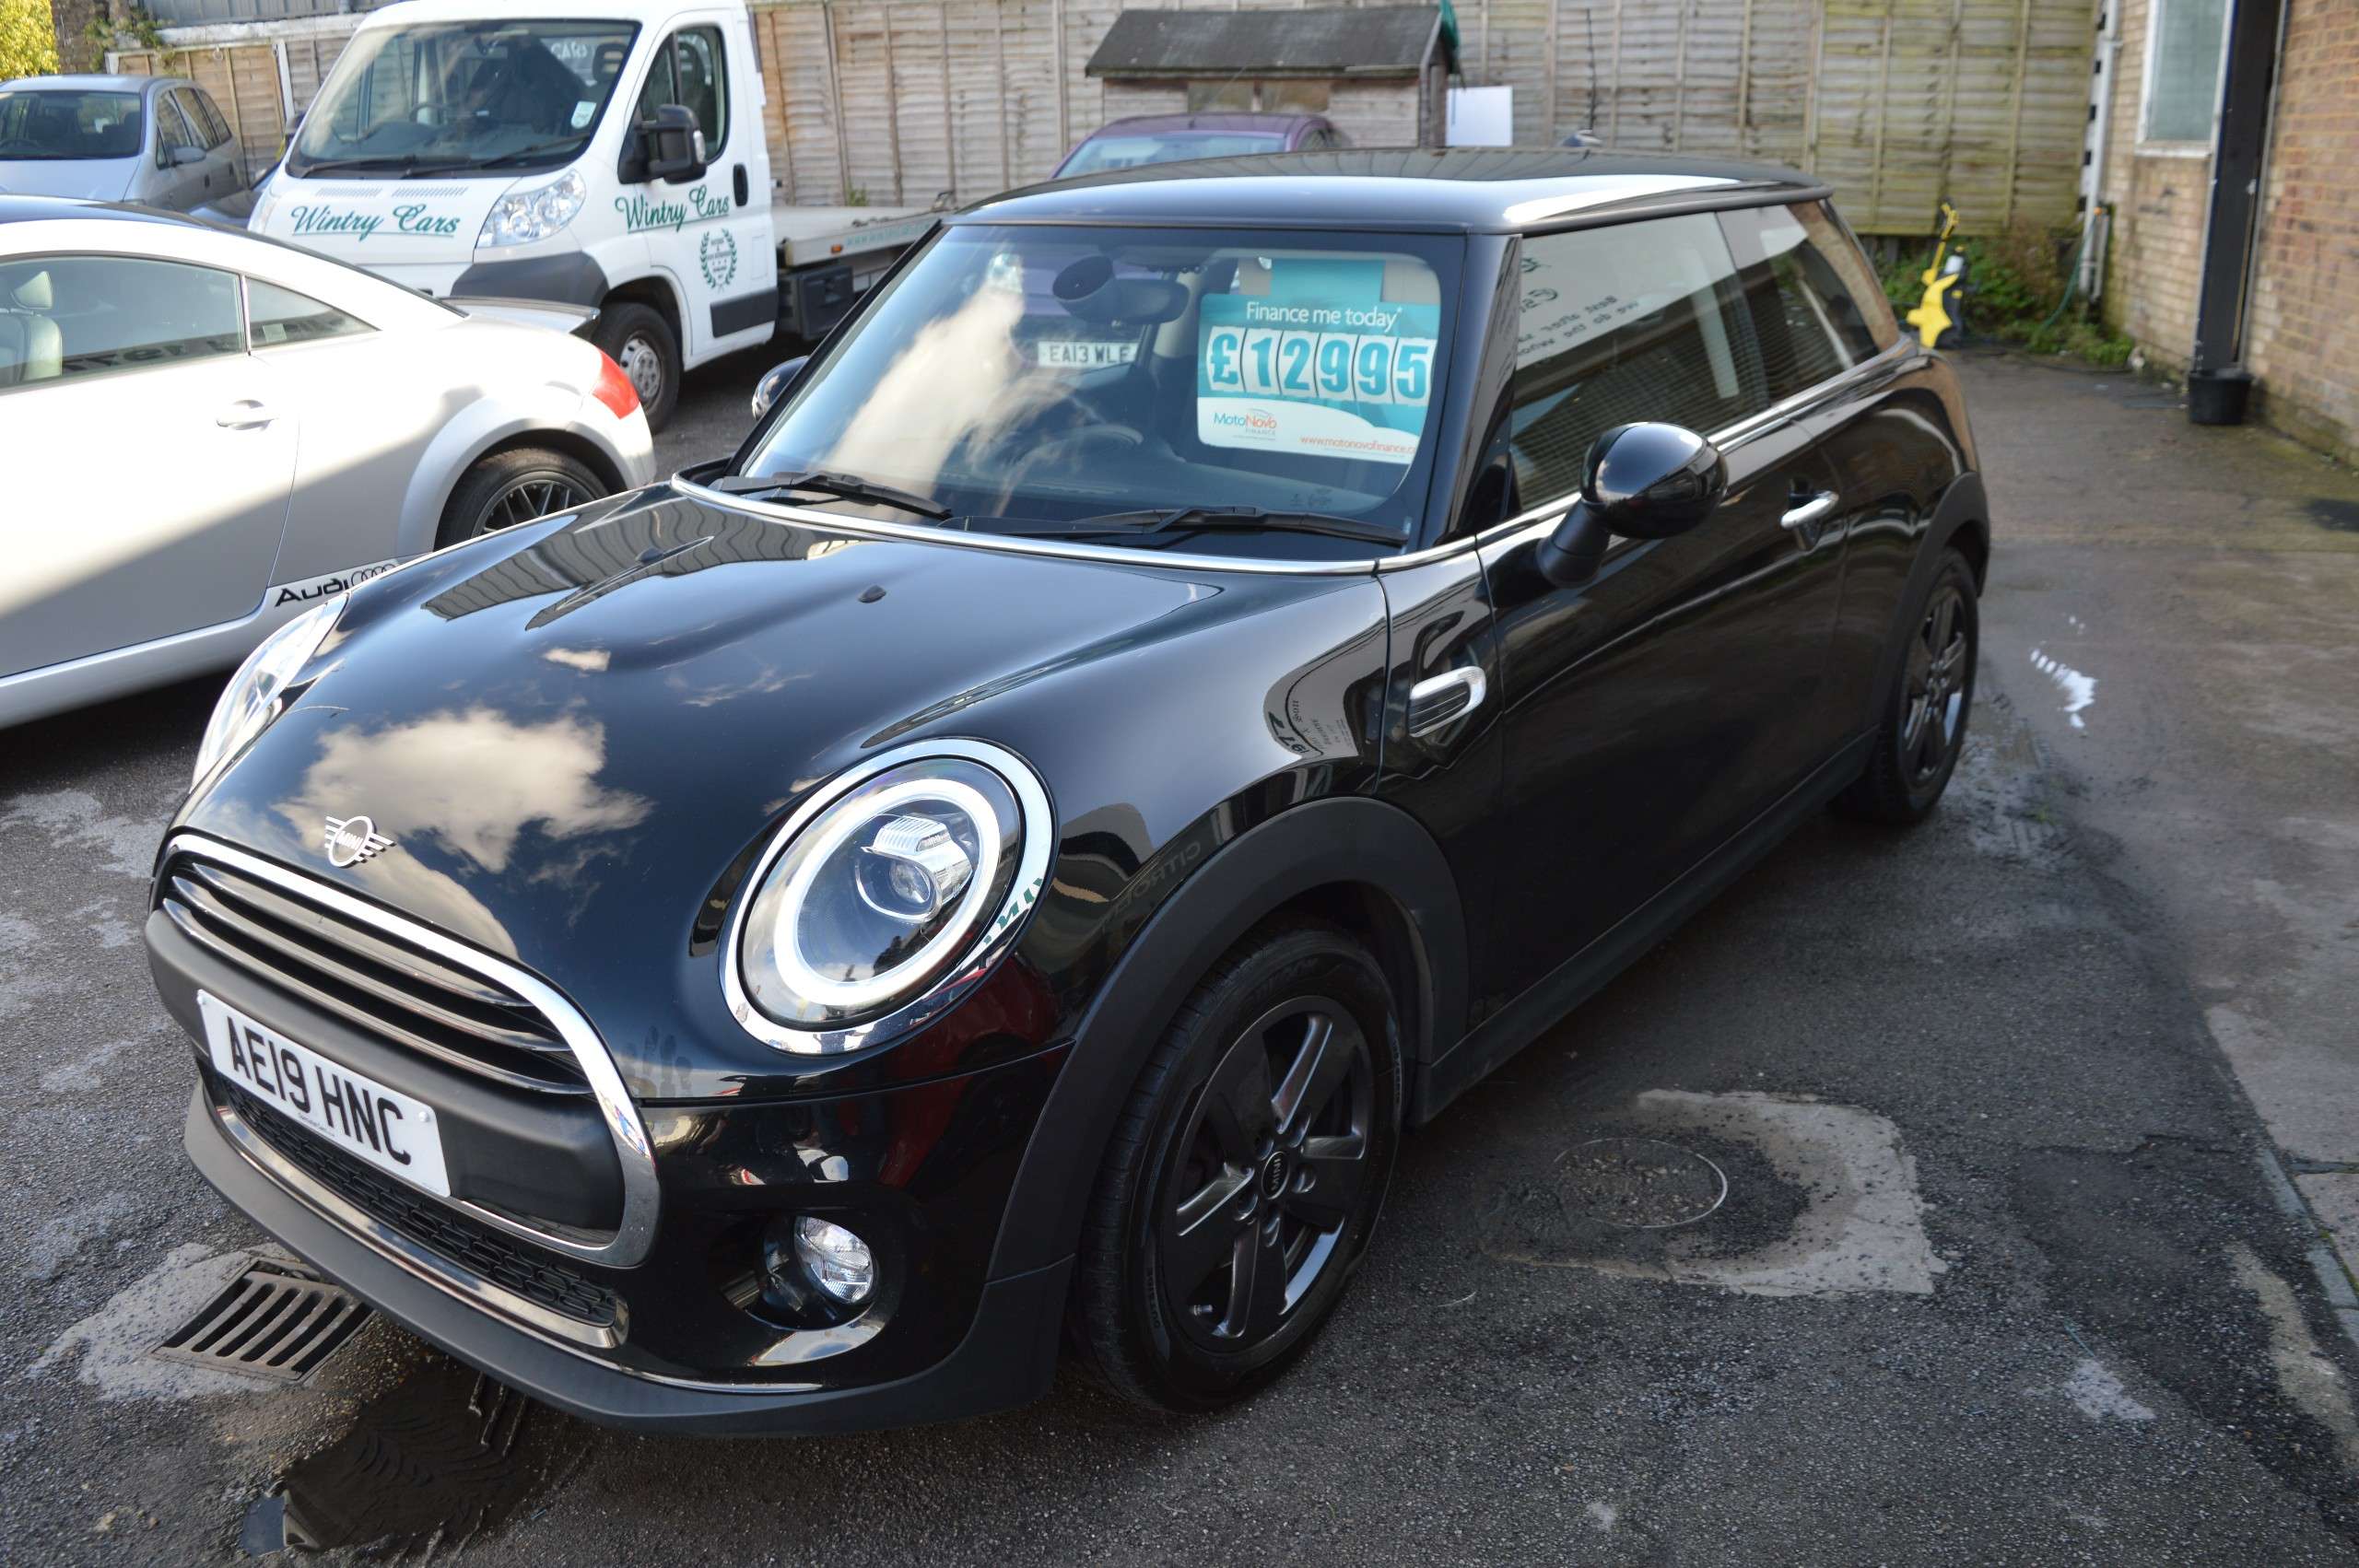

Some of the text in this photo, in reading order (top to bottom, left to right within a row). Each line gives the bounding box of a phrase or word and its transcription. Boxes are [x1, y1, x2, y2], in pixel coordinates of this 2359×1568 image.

[290, 204, 461, 241] Wintry Cars
[615, 184, 729, 232] Wintry Cars
[1246, 301, 1309, 322] Finance
[1313, 310, 1342, 324] me
[1210, 333, 1430, 400] £12995
[1213, 412, 1277, 429] MotoNovo
[227, 1016, 411, 1165] AE19 HNC
